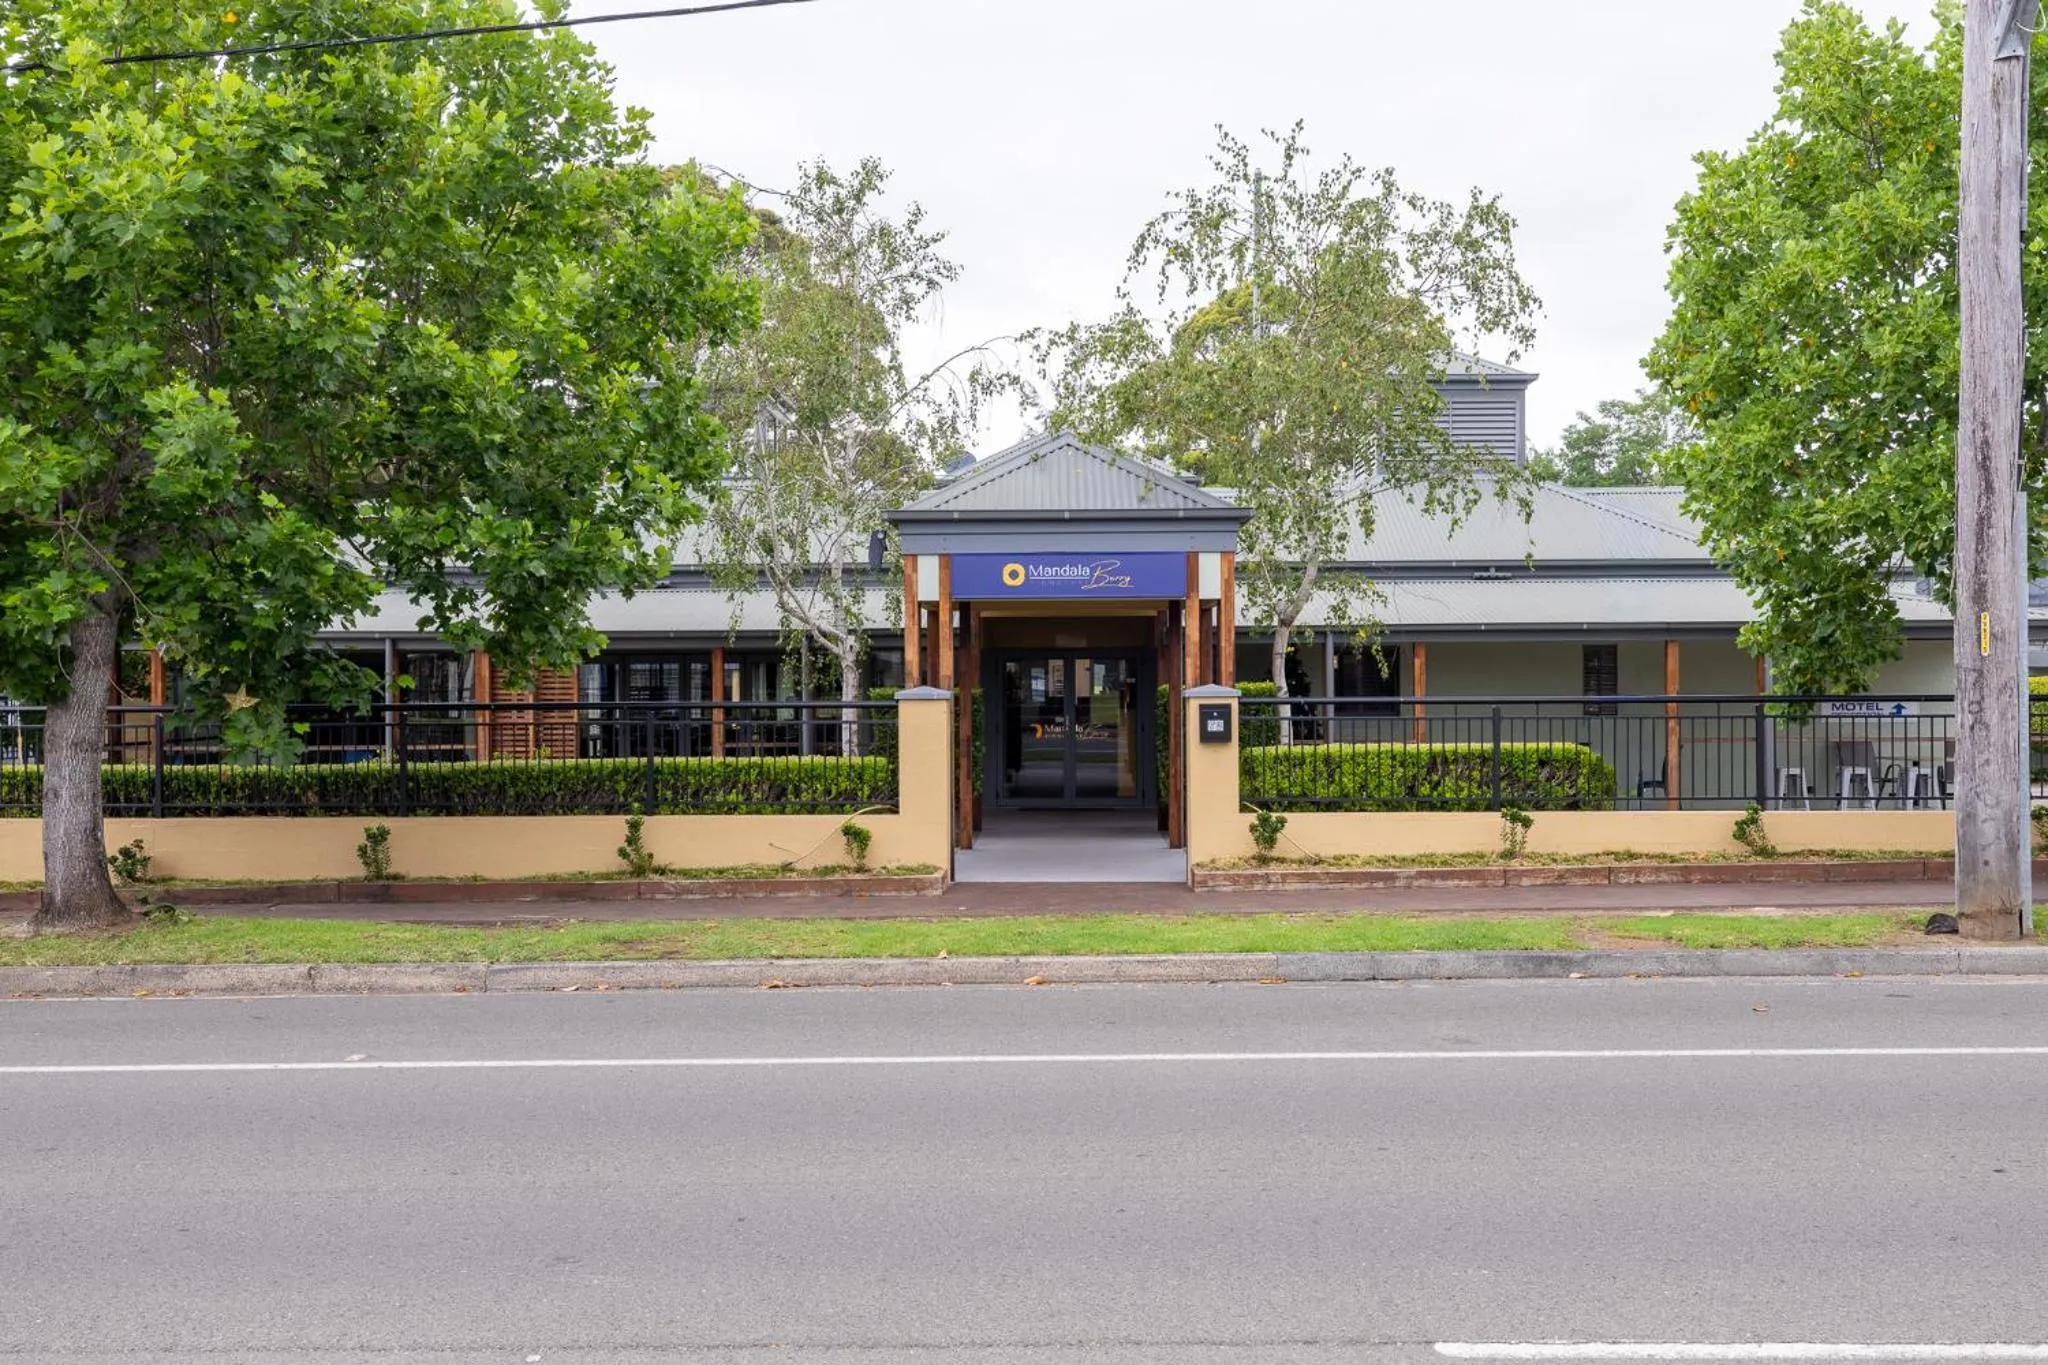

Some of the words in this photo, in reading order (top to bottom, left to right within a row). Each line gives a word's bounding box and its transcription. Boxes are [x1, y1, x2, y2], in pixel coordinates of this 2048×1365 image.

[1029, 564, 1090, 577] Mandala
[1081, 559, 1135, 590] Berry
[1832, 702, 1884, 711] MOTEL
